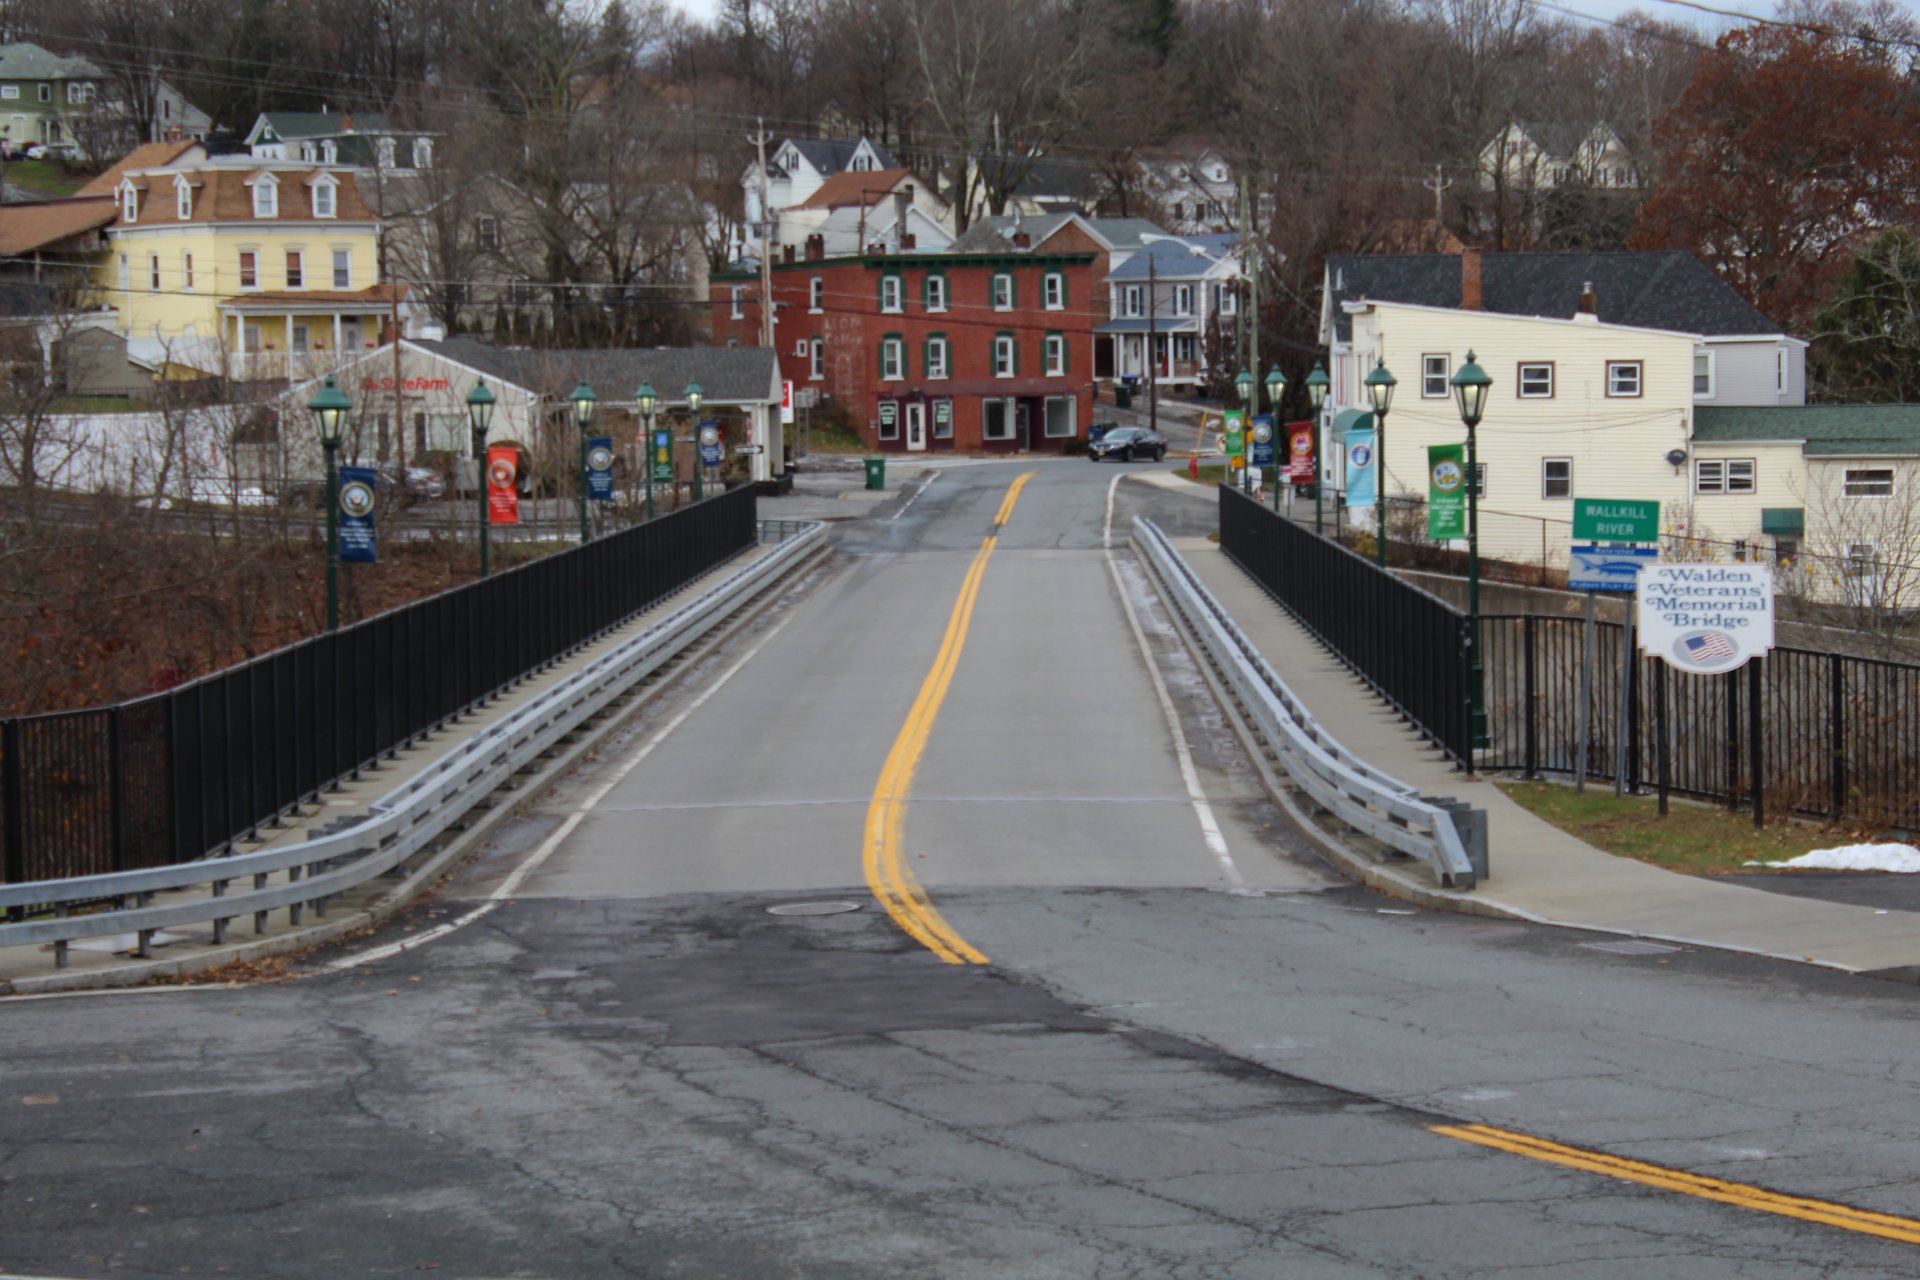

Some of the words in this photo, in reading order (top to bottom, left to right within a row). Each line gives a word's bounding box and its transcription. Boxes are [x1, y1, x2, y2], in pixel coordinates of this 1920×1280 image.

[381, 376, 448, 390] StteFarm
[1586, 505, 1647, 519] WALLKILL
[1596, 523, 1634, 535] RIVER
[1658, 568, 1752, 582] Walden
[1647, 582, 1765, 597] Veterans'
[1646, 597, 1767, 611] Memorial
[1663, 613, 1750, 630] Bridge
